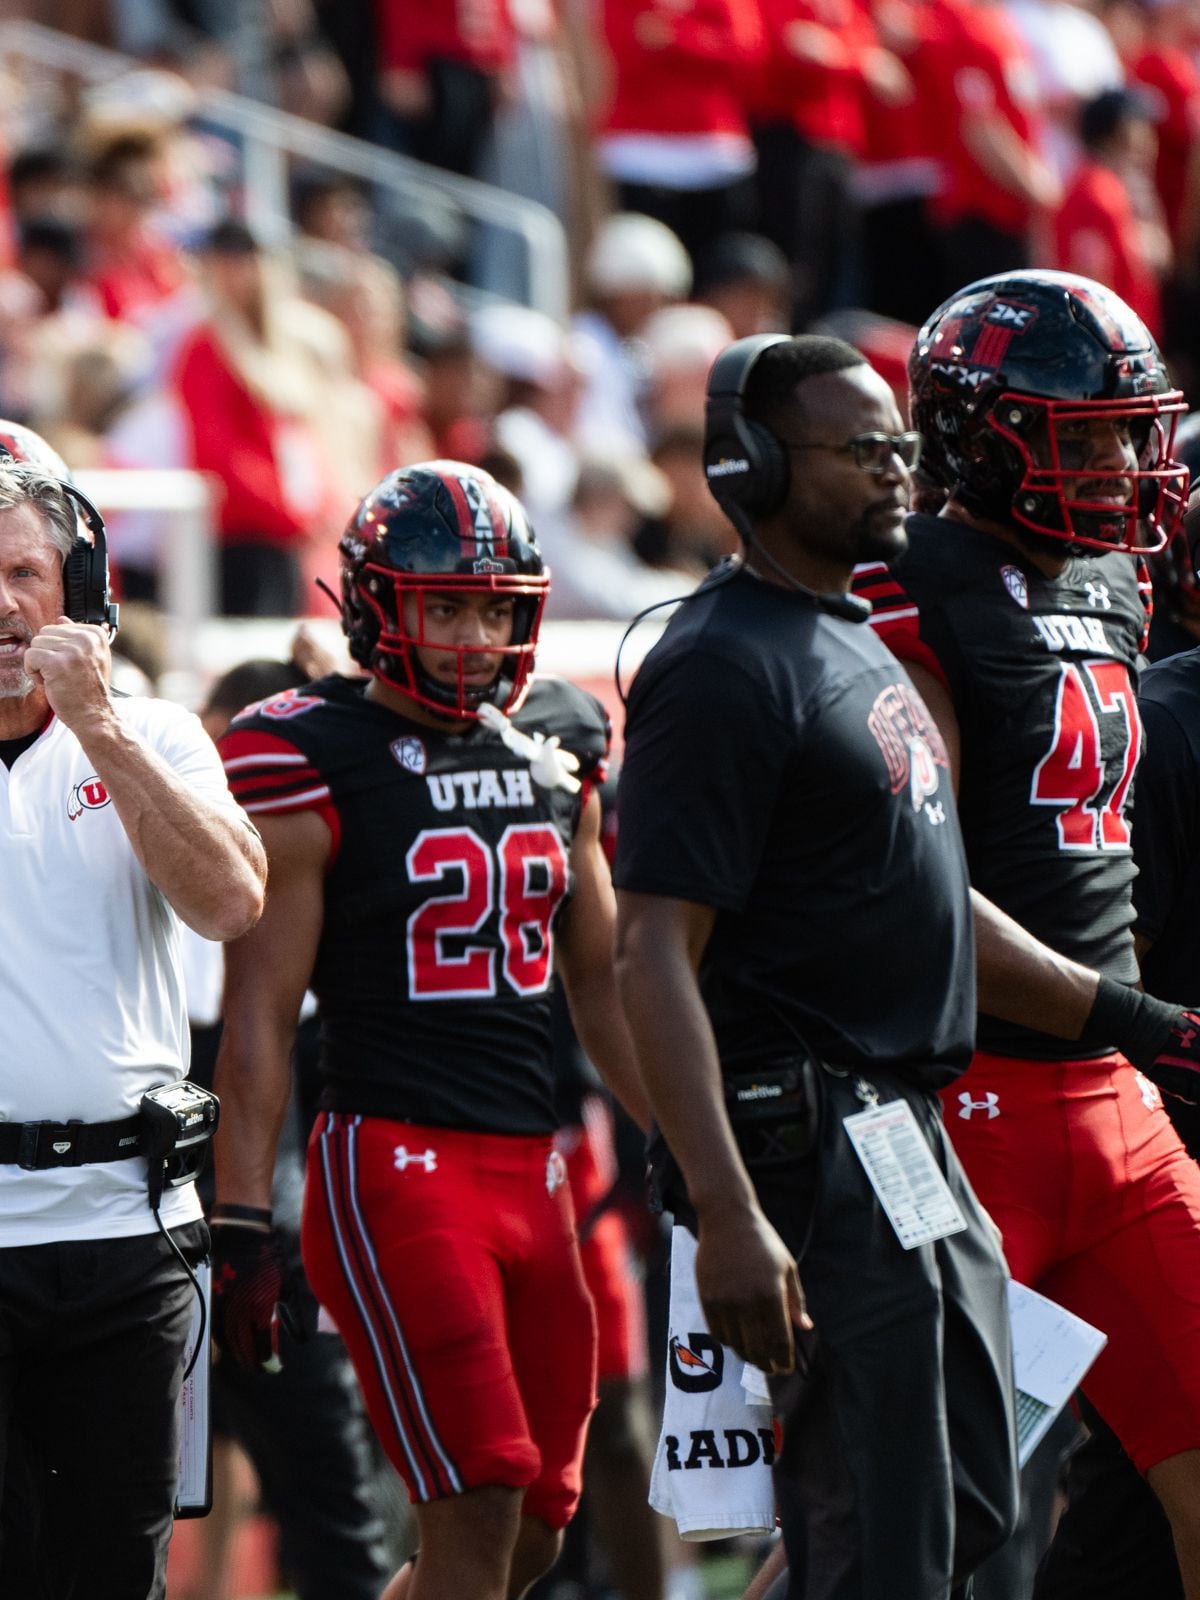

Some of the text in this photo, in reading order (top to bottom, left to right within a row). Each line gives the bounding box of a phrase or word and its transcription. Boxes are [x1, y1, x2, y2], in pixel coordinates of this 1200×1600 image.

[1032, 614, 1114, 655] UTAH
[1029, 660, 1142, 850] 47
[82, 781, 108, 806] U
[426, 770, 534, 812] UTAH
[405, 823, 569, 1001] 28
[669, 1332, 725, 1393] G
